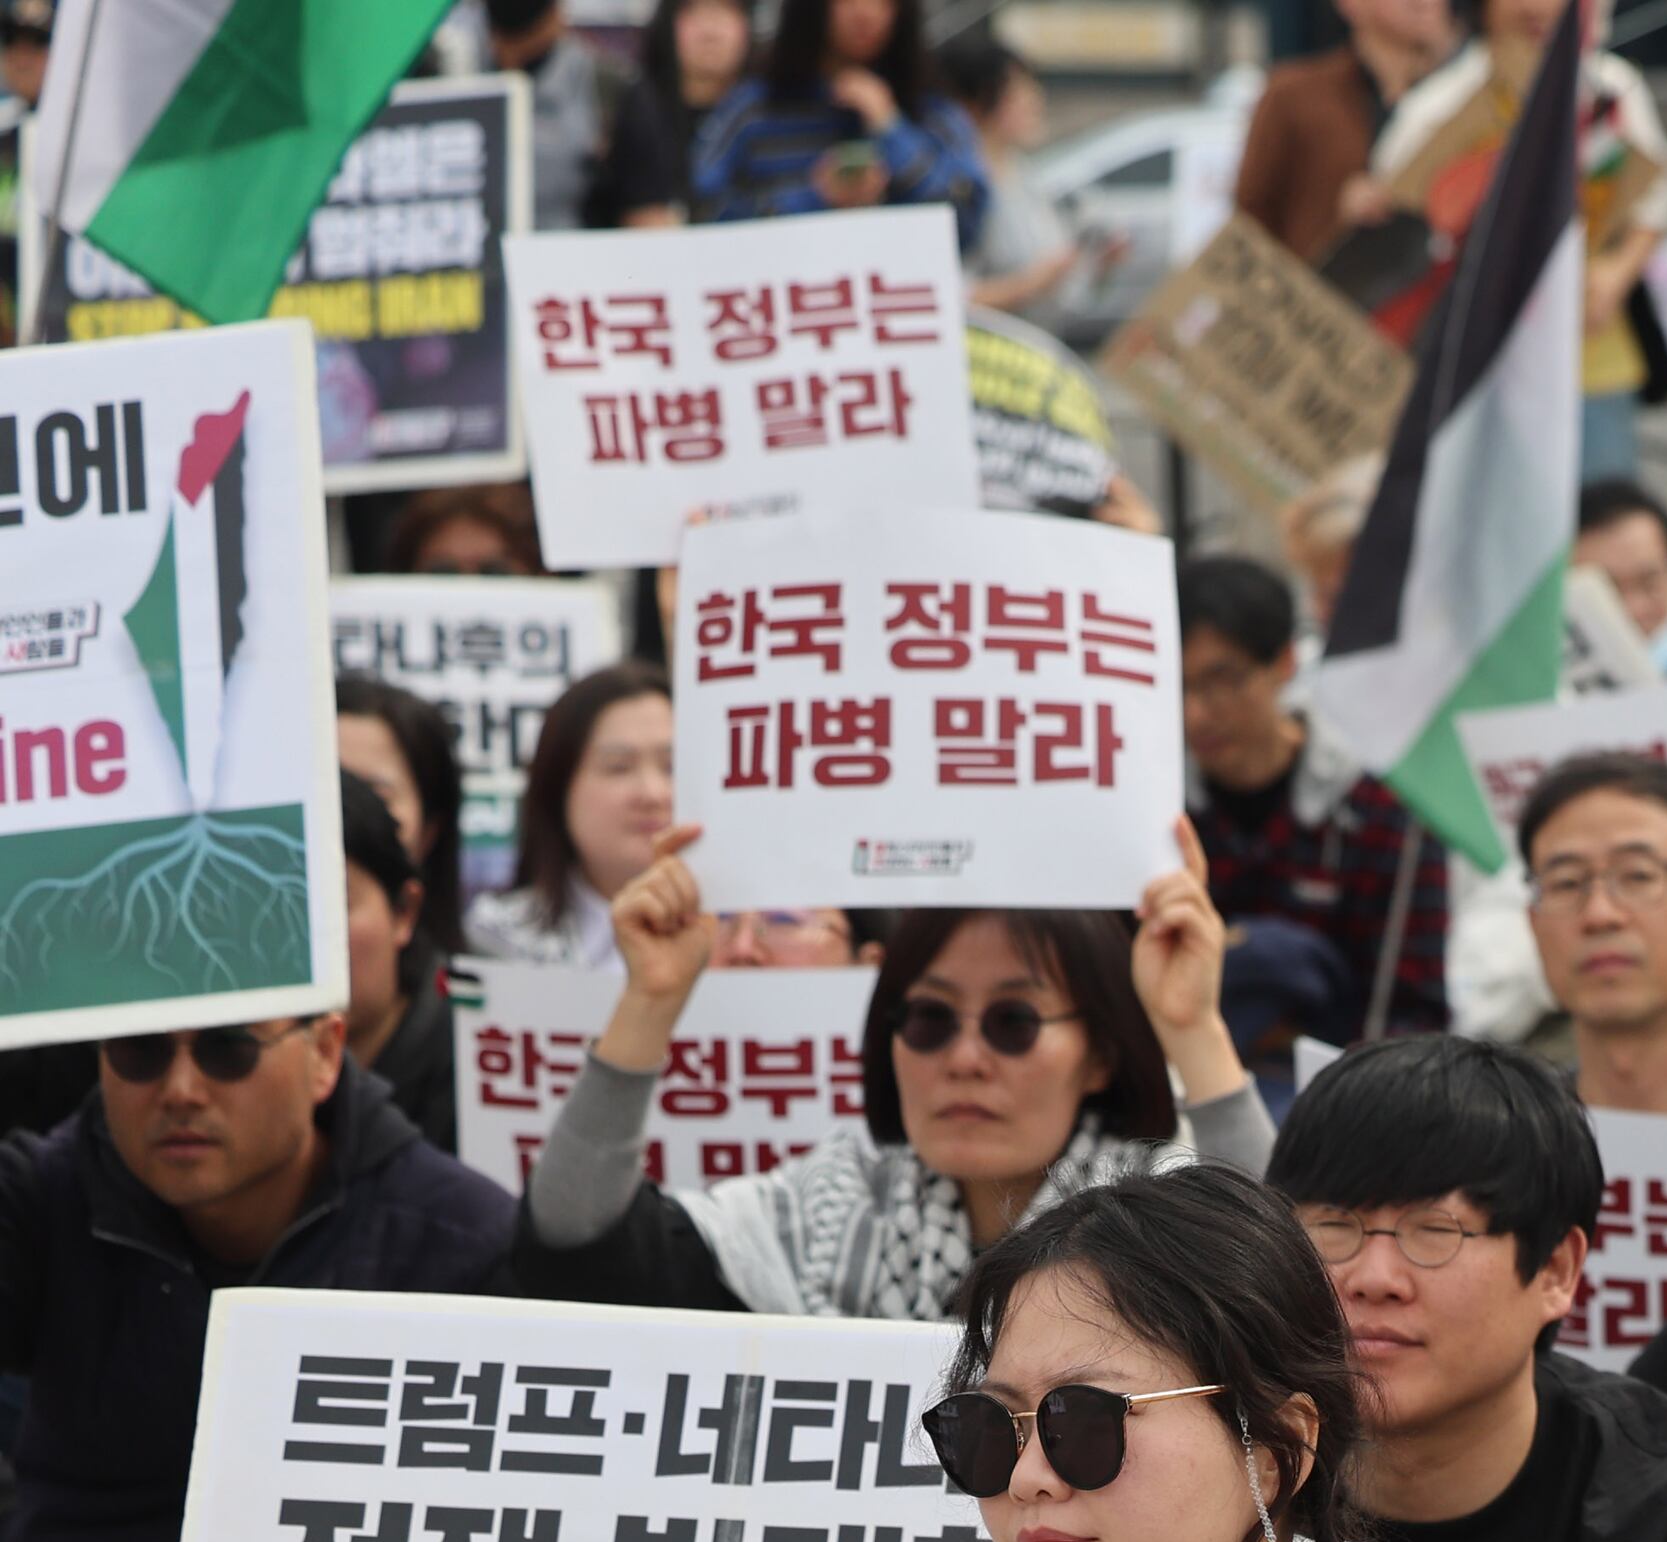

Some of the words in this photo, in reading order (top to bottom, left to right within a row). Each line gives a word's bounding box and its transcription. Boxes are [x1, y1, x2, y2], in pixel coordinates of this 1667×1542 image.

[535, 295, 673, 371] 한국
[704, 273, 938, 363] 정부는
[584, 388, 726, 464] 파병
[755, 368, 912, 450] 말라
[333, 615, 570, 680] 타냐후의
[697, 584, 844, 683] 한국
[884, 583, 1155, 685] 정부는
[723, 698, 891, 789] 파병
[934, 699, 1122, 787] 말라
